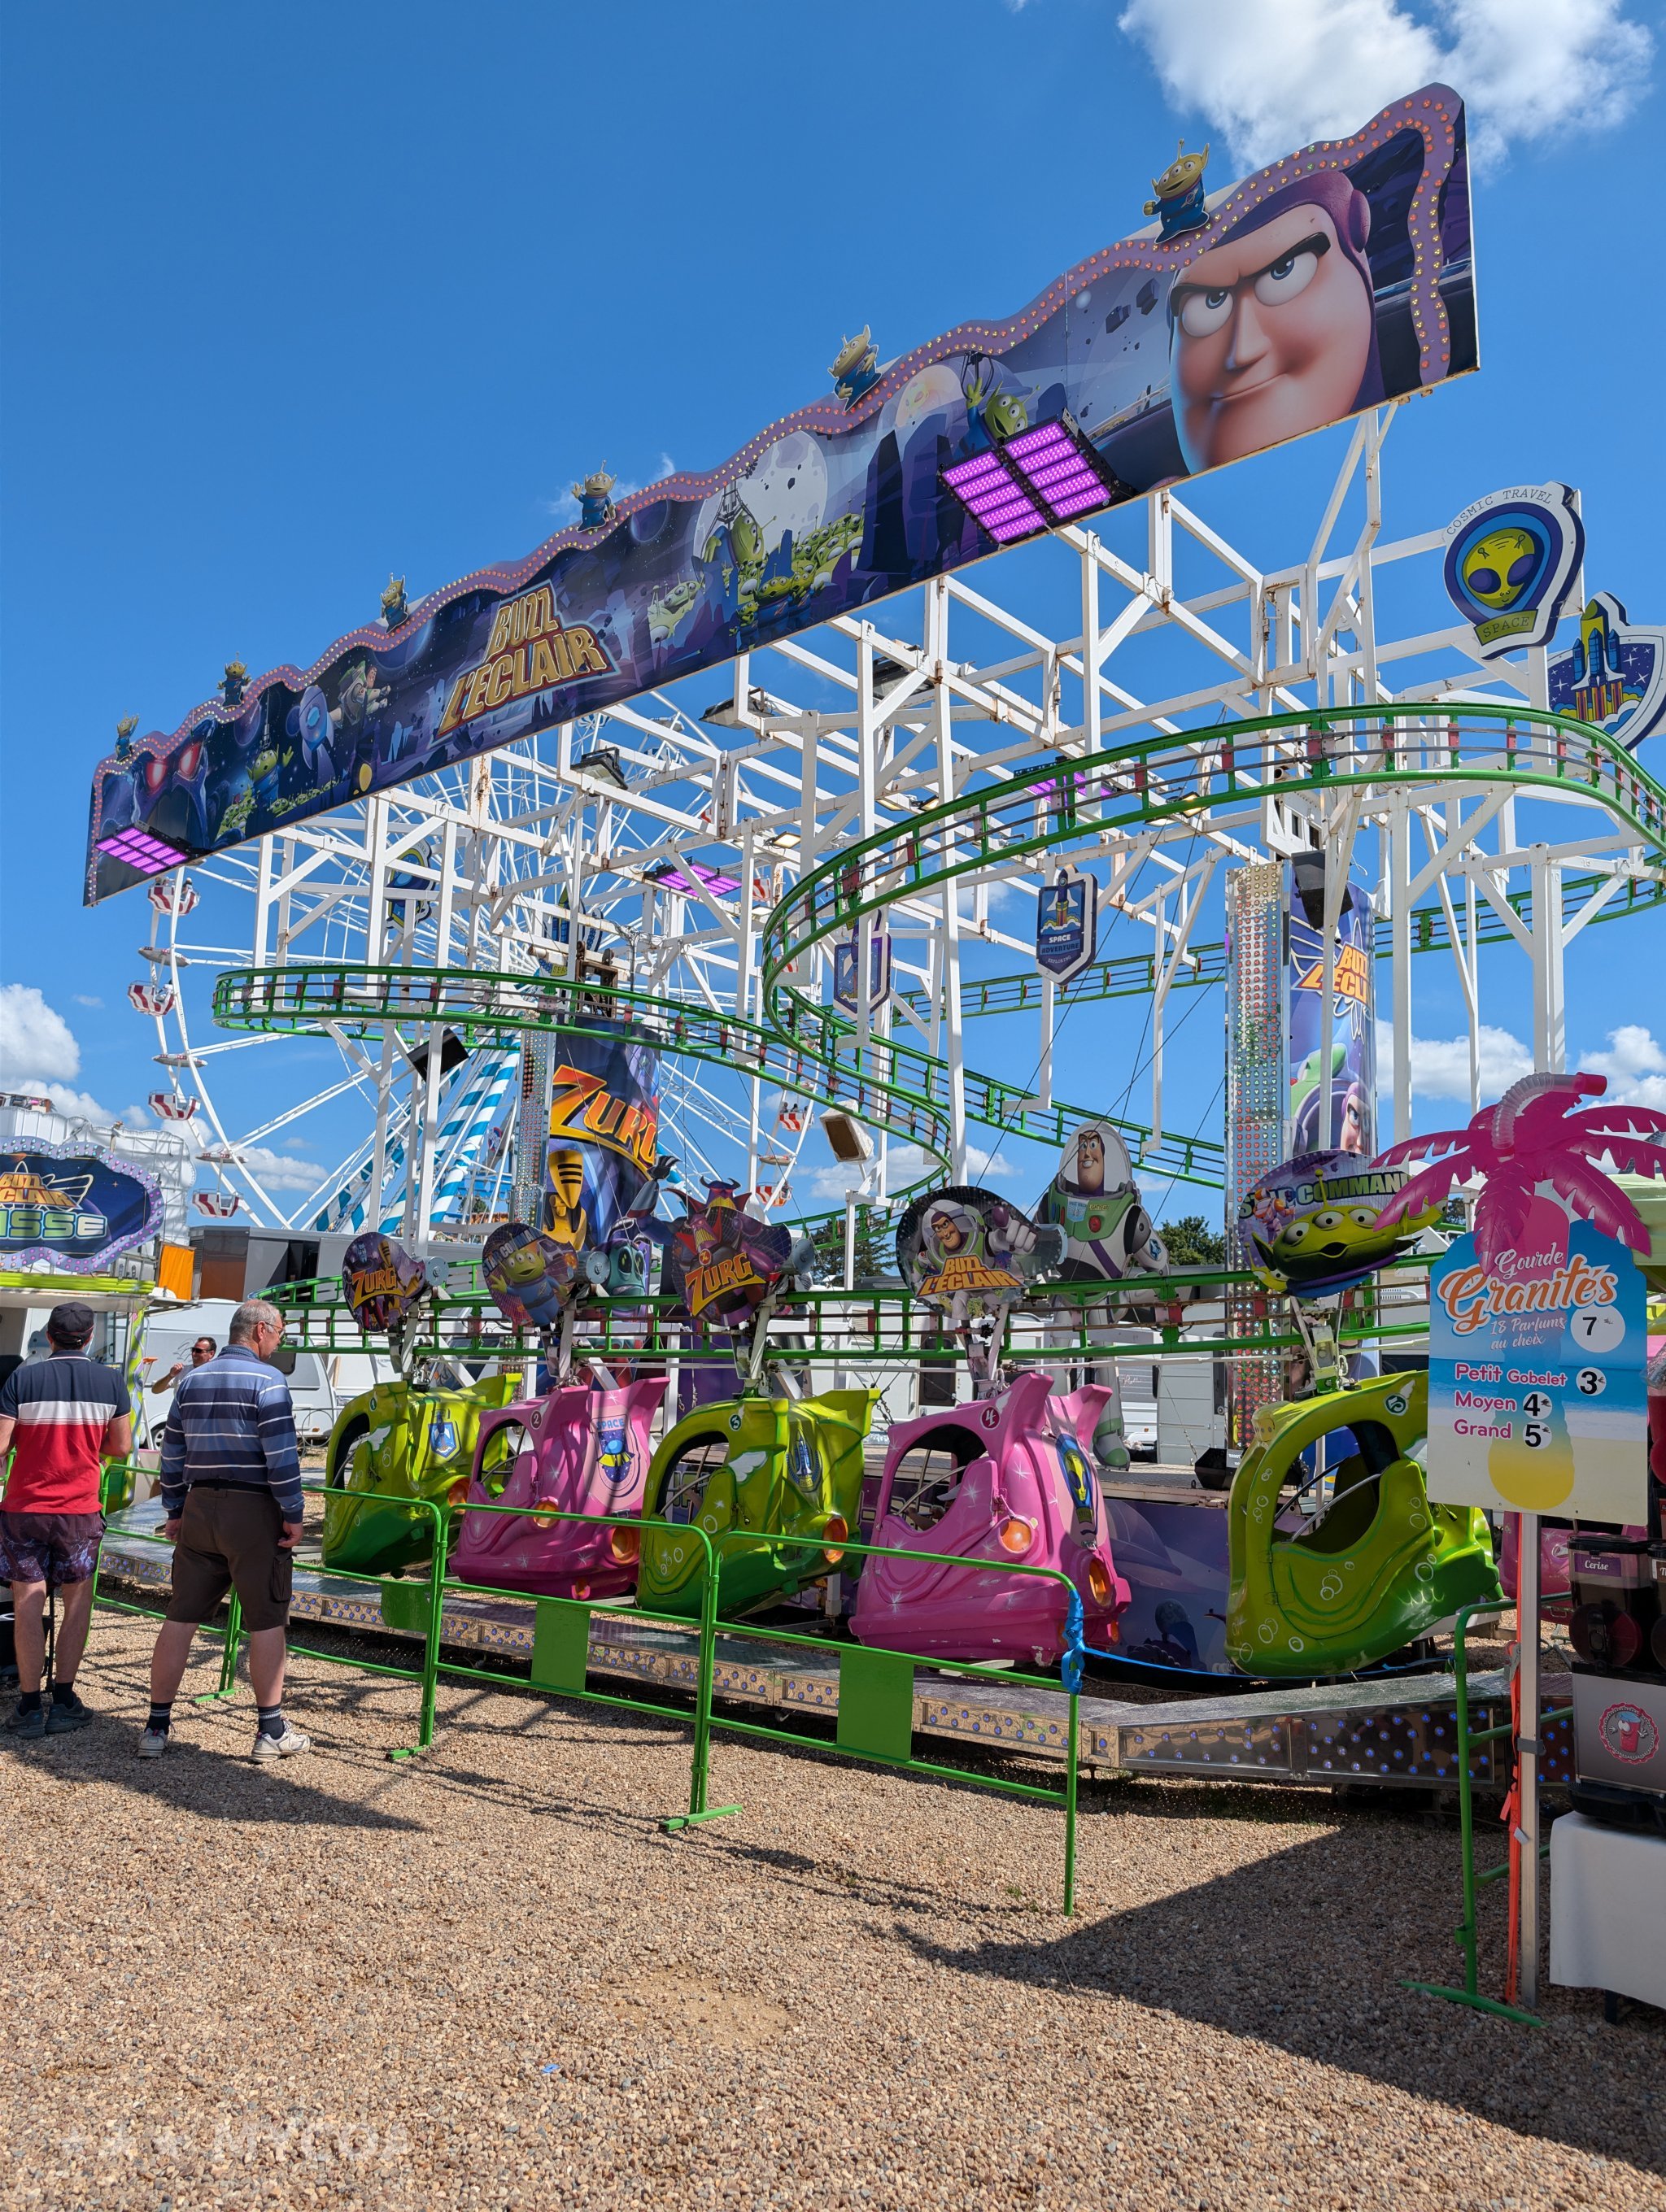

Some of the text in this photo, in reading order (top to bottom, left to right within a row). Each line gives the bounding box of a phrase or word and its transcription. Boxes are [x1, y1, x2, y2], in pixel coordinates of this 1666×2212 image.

[1446, 488, 1553, 535] COSMIC TRAVEL
[484, 587, 559, 663] BUZZ
[1483, 616, 1530, 638] SPACE
[438, 628, 607, 733] L'ECLAIR
[1049, 934, 1071, 943] SPACE
[942, 1256, 988, 1277] BUZZ
[1494, 1241, 1564, 1279] Gourde
[352, 1269, 404, 1310] ZURG
[685, 1252, 766, 1317] ZURG
[918, 1270, 1023, 1296] L'ECLAIR
[1438, 1255, 1617, 1334] Granités
[1490, 1315, 1567, 1335] 18 Parfums
[1490, 1333, 1546, 1350] au choix
[1454, 1363, 1502, 1382] Petit
[1507, 1369, 1567, 1386] Gobelet
[1388, 1396, 1404, 1413] 5
[1454, 1391, 1516, 1412] Moyen
[533, 1413, 540, 1425] 2
[596, 1417, 626, 1430] SPACE
[985, 1409, 997, 1426] 4
[1454, 1419, 1512, 1439] Grand
[1584, 1560, 1609, 1570] Cerise
